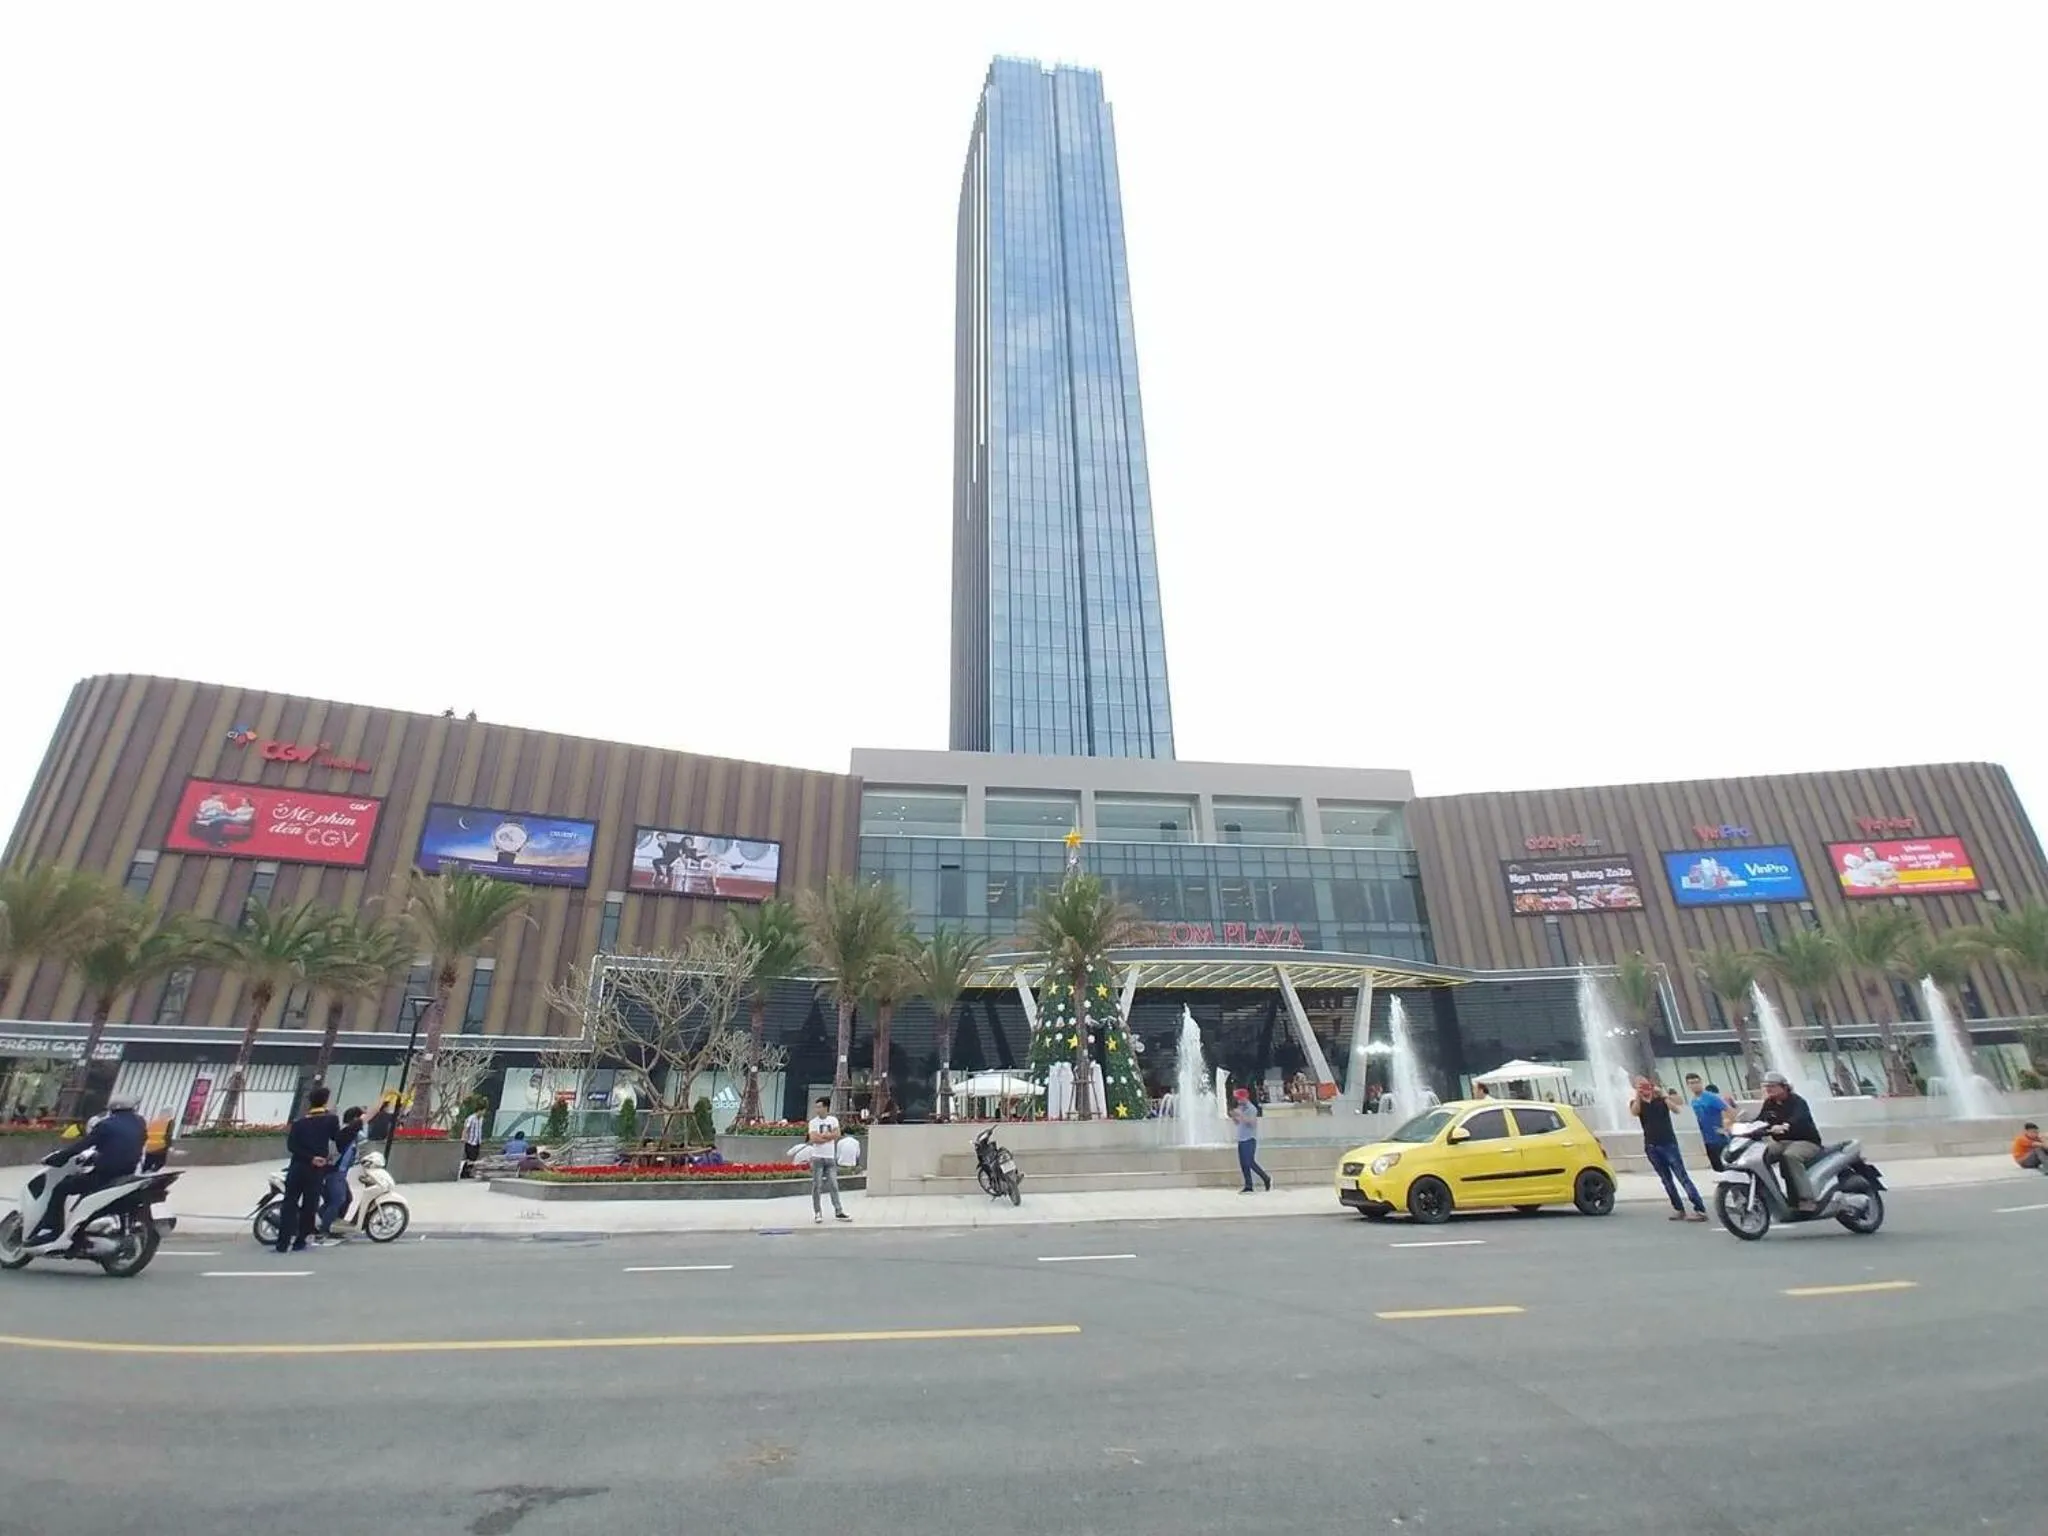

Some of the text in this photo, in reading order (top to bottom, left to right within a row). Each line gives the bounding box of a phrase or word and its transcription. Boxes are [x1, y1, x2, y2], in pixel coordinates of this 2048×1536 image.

[304, 811, 357, 827] phim
[304, 827, 360, 848] CGV
[1743, 862, 1790, 877] VinPro
[1223, 921, 1305, 947] PLAZA
